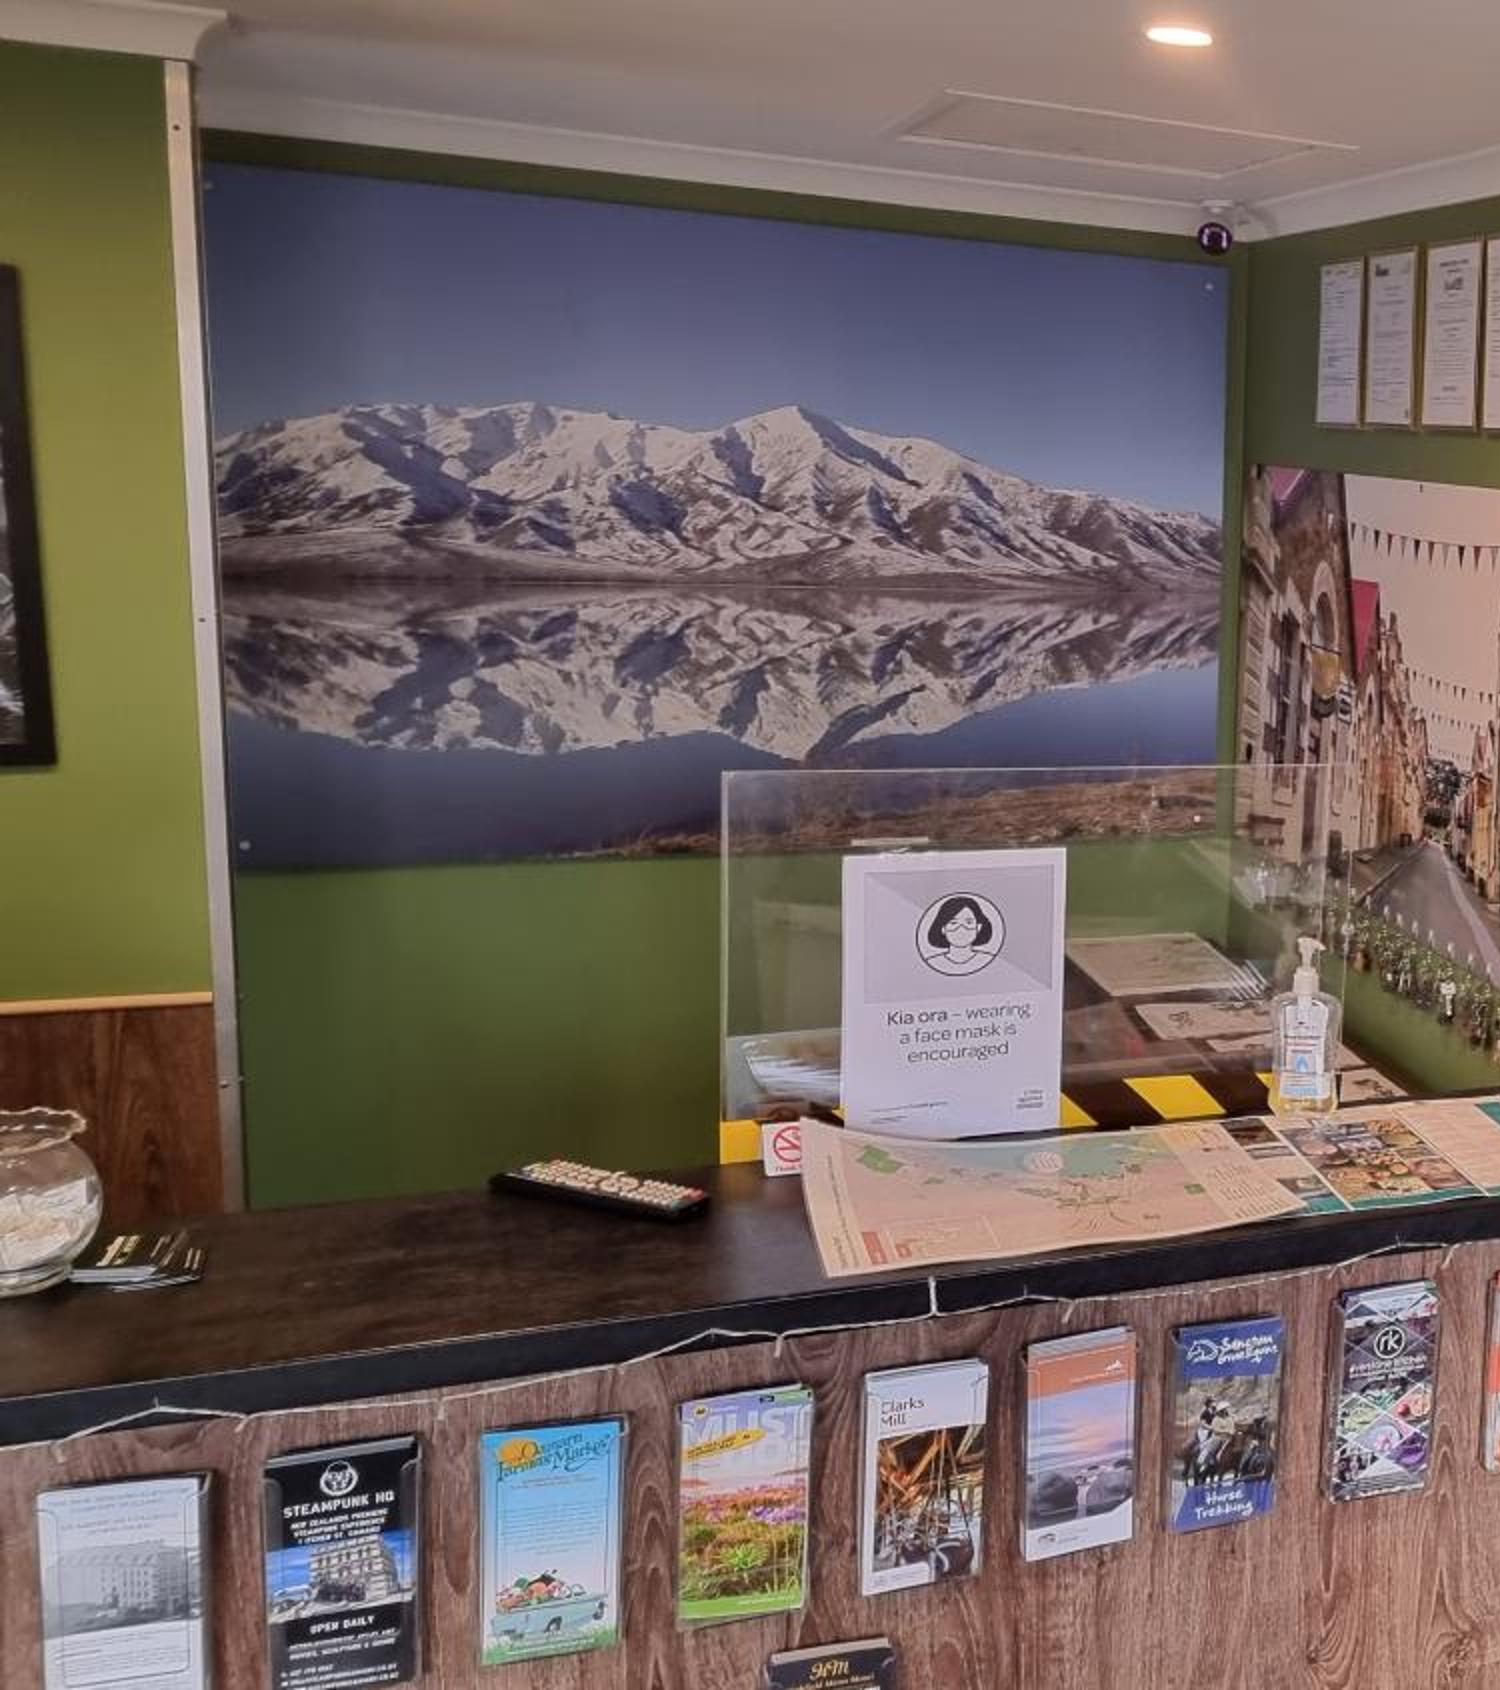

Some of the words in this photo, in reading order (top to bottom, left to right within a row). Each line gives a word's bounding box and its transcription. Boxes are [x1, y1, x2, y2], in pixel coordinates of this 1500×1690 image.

[887, 1010, 914, 1026] Kia
[918, 1008, 948, 1024] ora
[965, 1001, 1031, 1020] wearing
[899, 1032, 910, 1044] a
[915, 1027, 951, 1043] face
[955, 1022, 1000, 1040] mask
[1002, 1021, 1017, 1036] is
[907, 1040, 1009, 1063] encouraged
[881, 1397, 925, 1414] Clarks
[881, 1413, 906, 1427] Mill
[283, 1493, 369, 1519] STEAMPUNK
[375, 1489, 395, 1504] HQ
[310, 1621, 339, 1634] OPEN
[343, 1615, 375, 1629] DAILY
